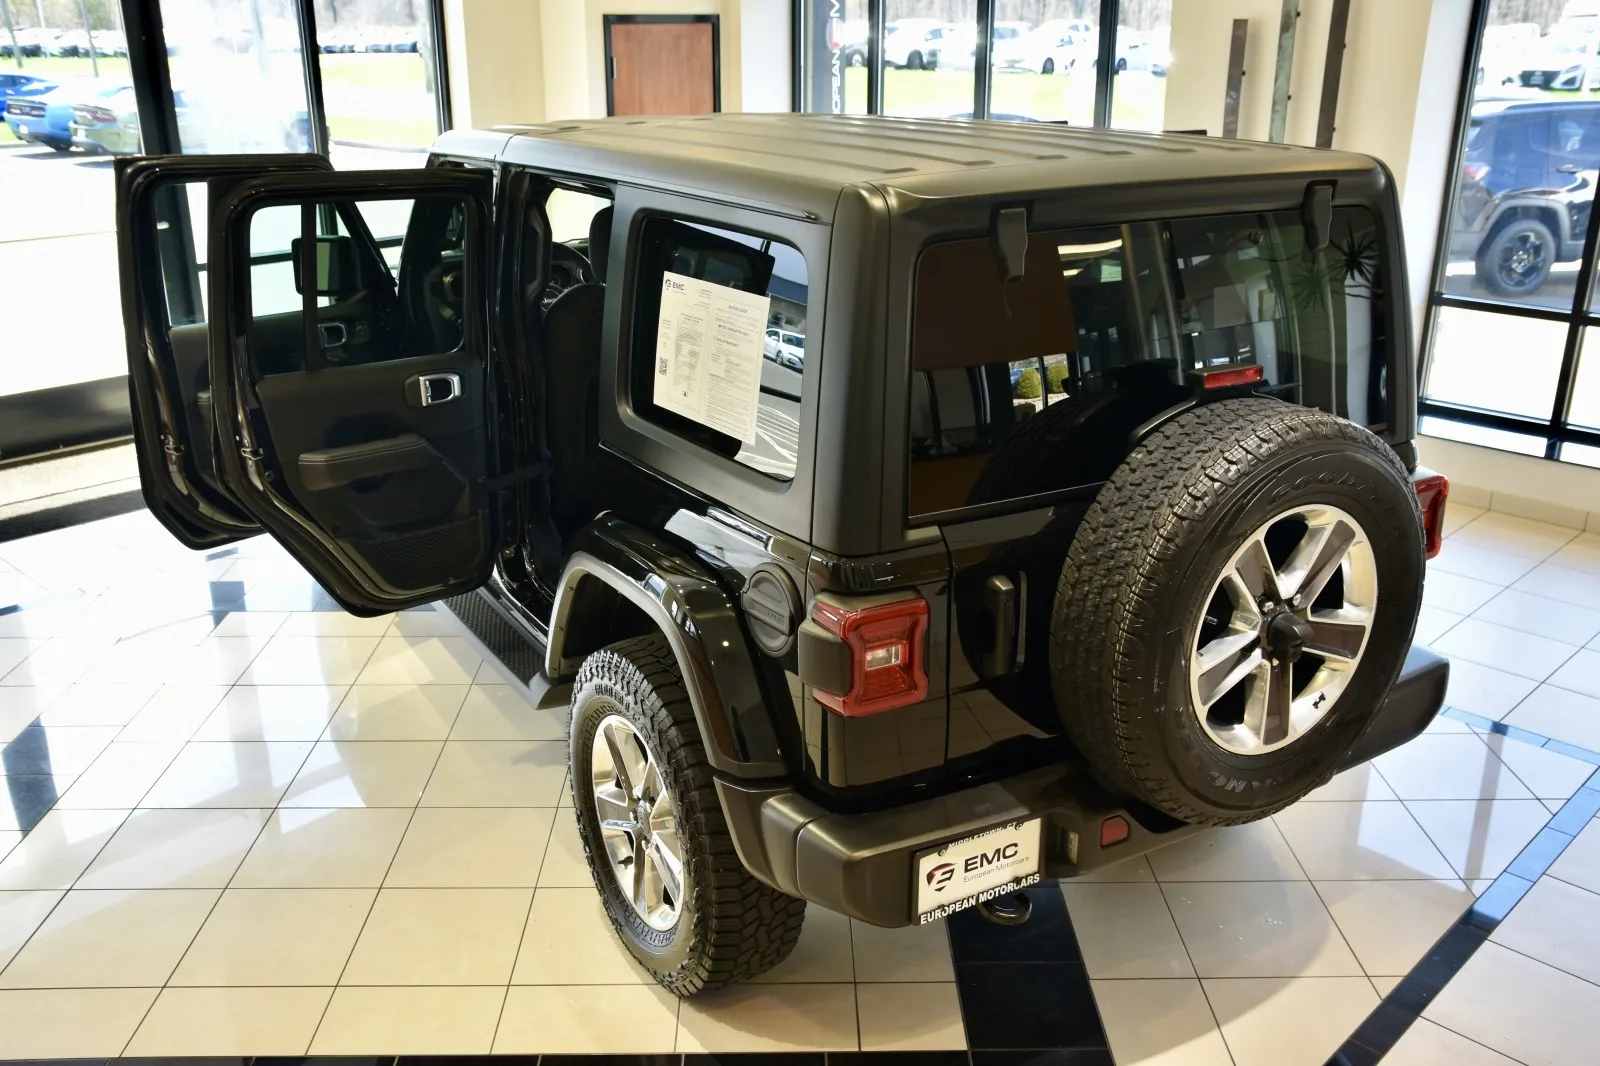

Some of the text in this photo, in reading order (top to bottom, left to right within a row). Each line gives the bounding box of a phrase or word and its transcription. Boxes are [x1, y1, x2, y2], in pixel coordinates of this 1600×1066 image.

[672, 281, 685, 291] EMC
[963, 842, 1019, 873] EMC
[963, 856, 1030, 883] European Motorcars
[920, 873, 1040, 925] EUROPEAN MOTORCARS
